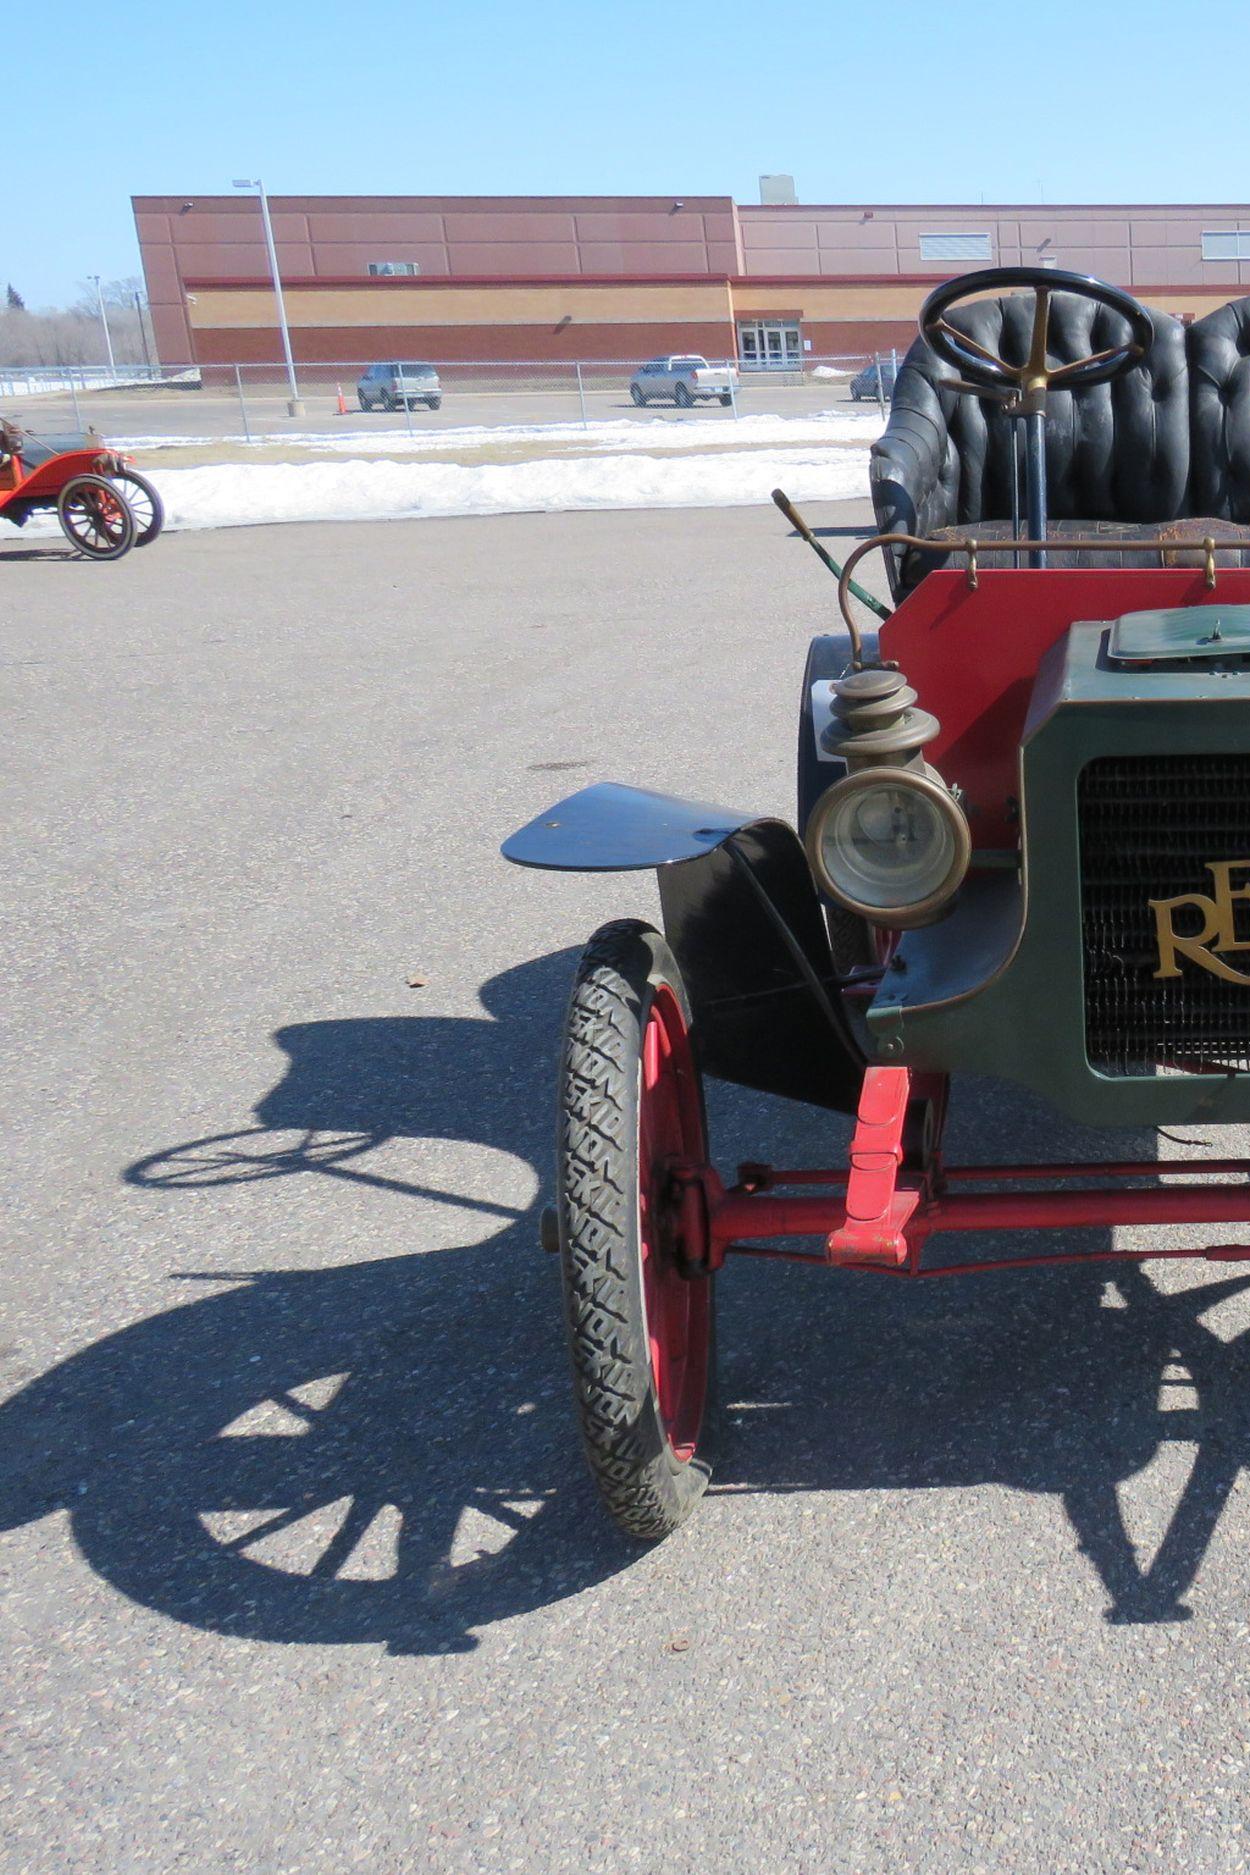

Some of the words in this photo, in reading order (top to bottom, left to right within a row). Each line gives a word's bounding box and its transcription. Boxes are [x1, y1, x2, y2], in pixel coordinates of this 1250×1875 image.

[564, 1073, 624, 1151] SKID
[566, 1037, 624, 1109] NON
[564, 1109, 624, 1194] NON
[564, 1151, 625, 1237] SKID
[564, 1192, 626, 1281] NON
[567, 1239, 628, 1324] SKID
[573, 1290, 632, 1364] NON
